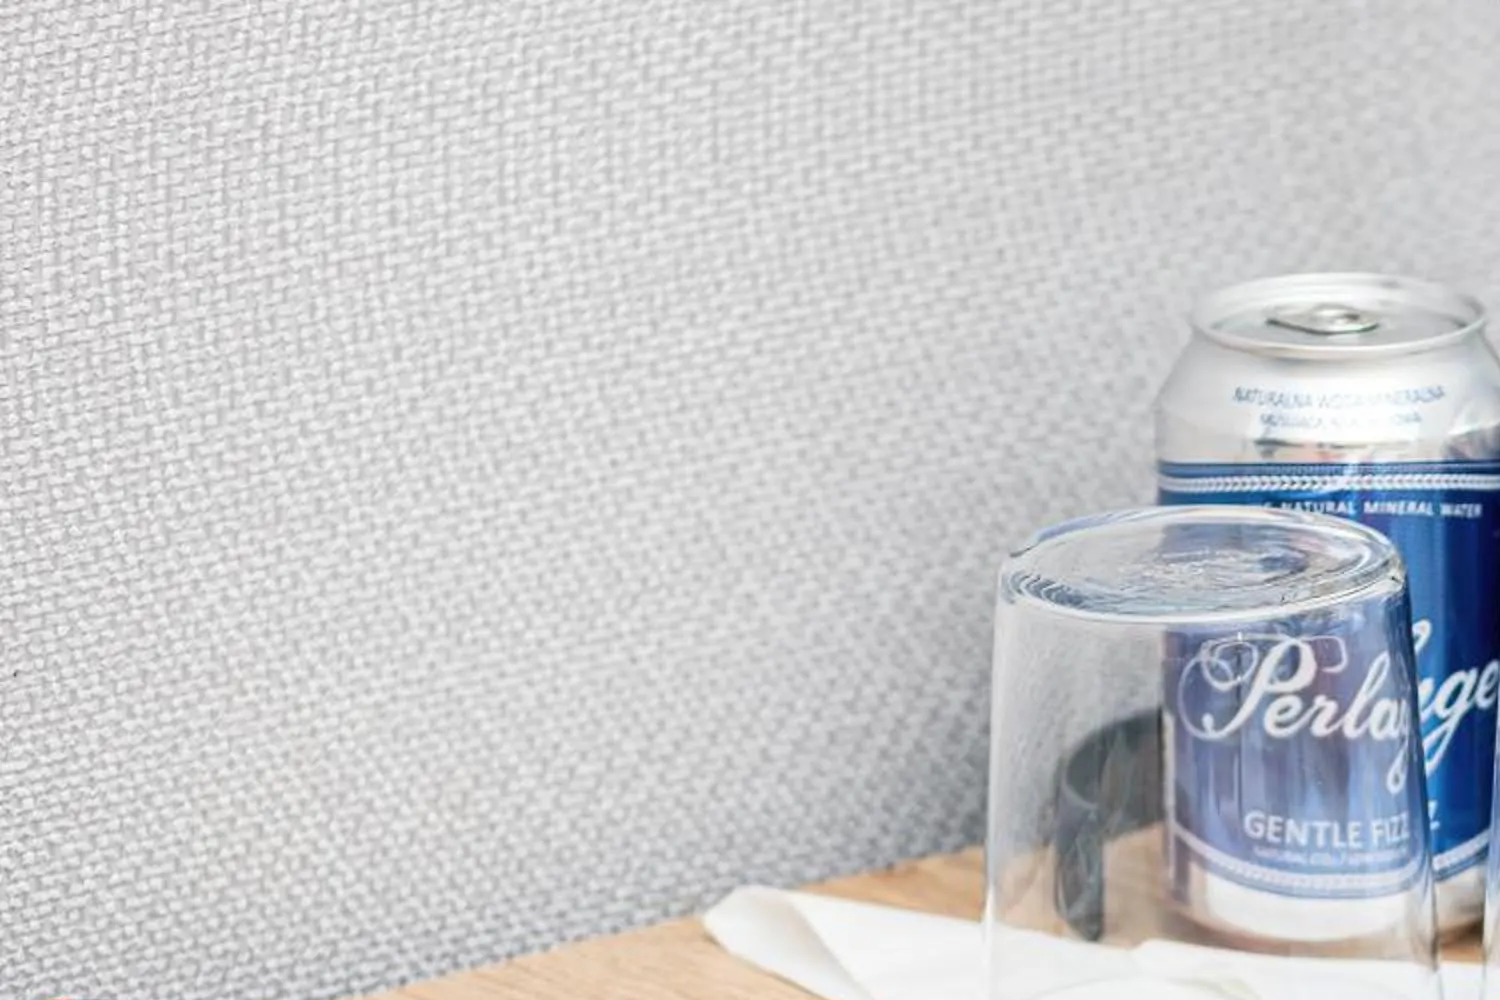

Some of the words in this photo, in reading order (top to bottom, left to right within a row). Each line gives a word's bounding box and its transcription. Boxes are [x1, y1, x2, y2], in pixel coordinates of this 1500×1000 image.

[1363, 500, 1434, 516] MINERAL
[1440, 503, 1483, 518] WATER
[1244, 809, 1364, 849] GENTLE
